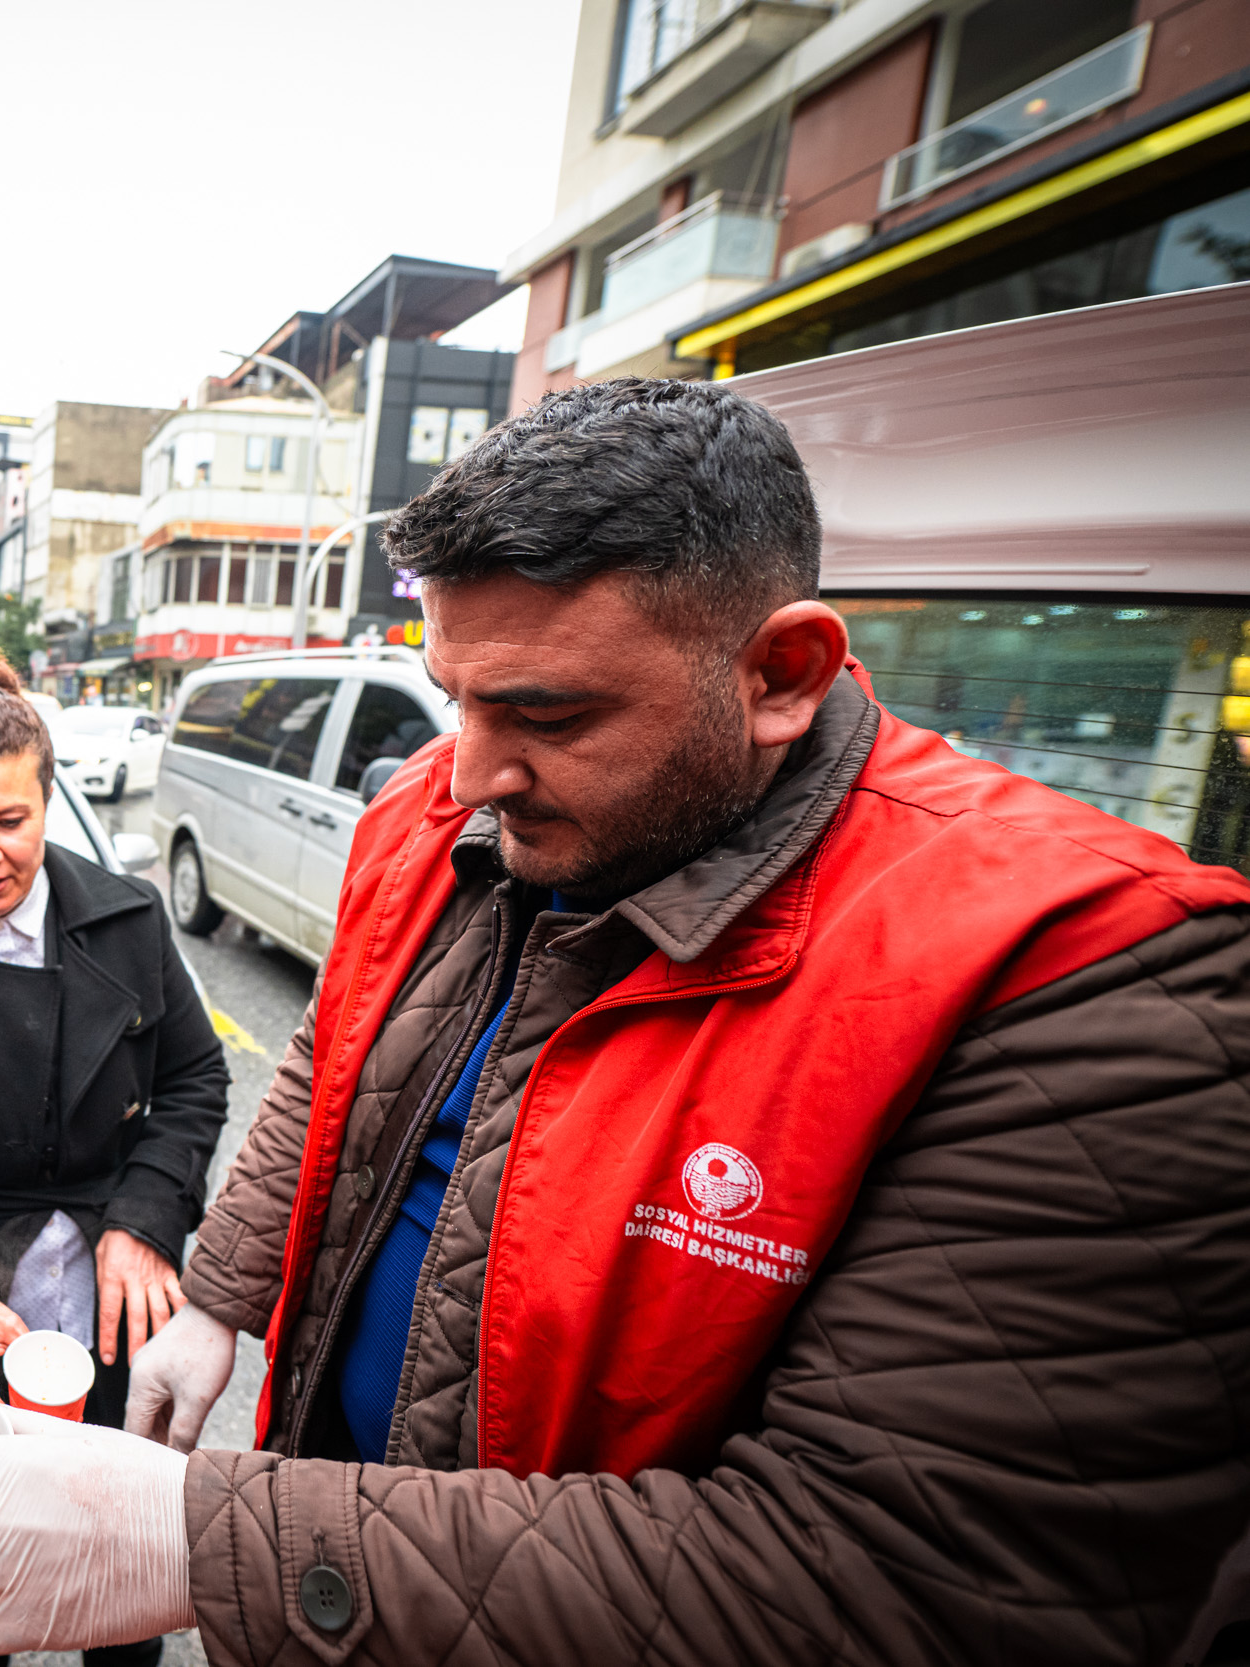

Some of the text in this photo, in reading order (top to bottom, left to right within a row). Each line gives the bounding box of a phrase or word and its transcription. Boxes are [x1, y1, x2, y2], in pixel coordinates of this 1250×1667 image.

[625, 1221, 686, 1250] DAİRESİ
[634, 1203, 690, 1232] SOSYAL
[693, 1219, 809, 1267] HİZMETLER
